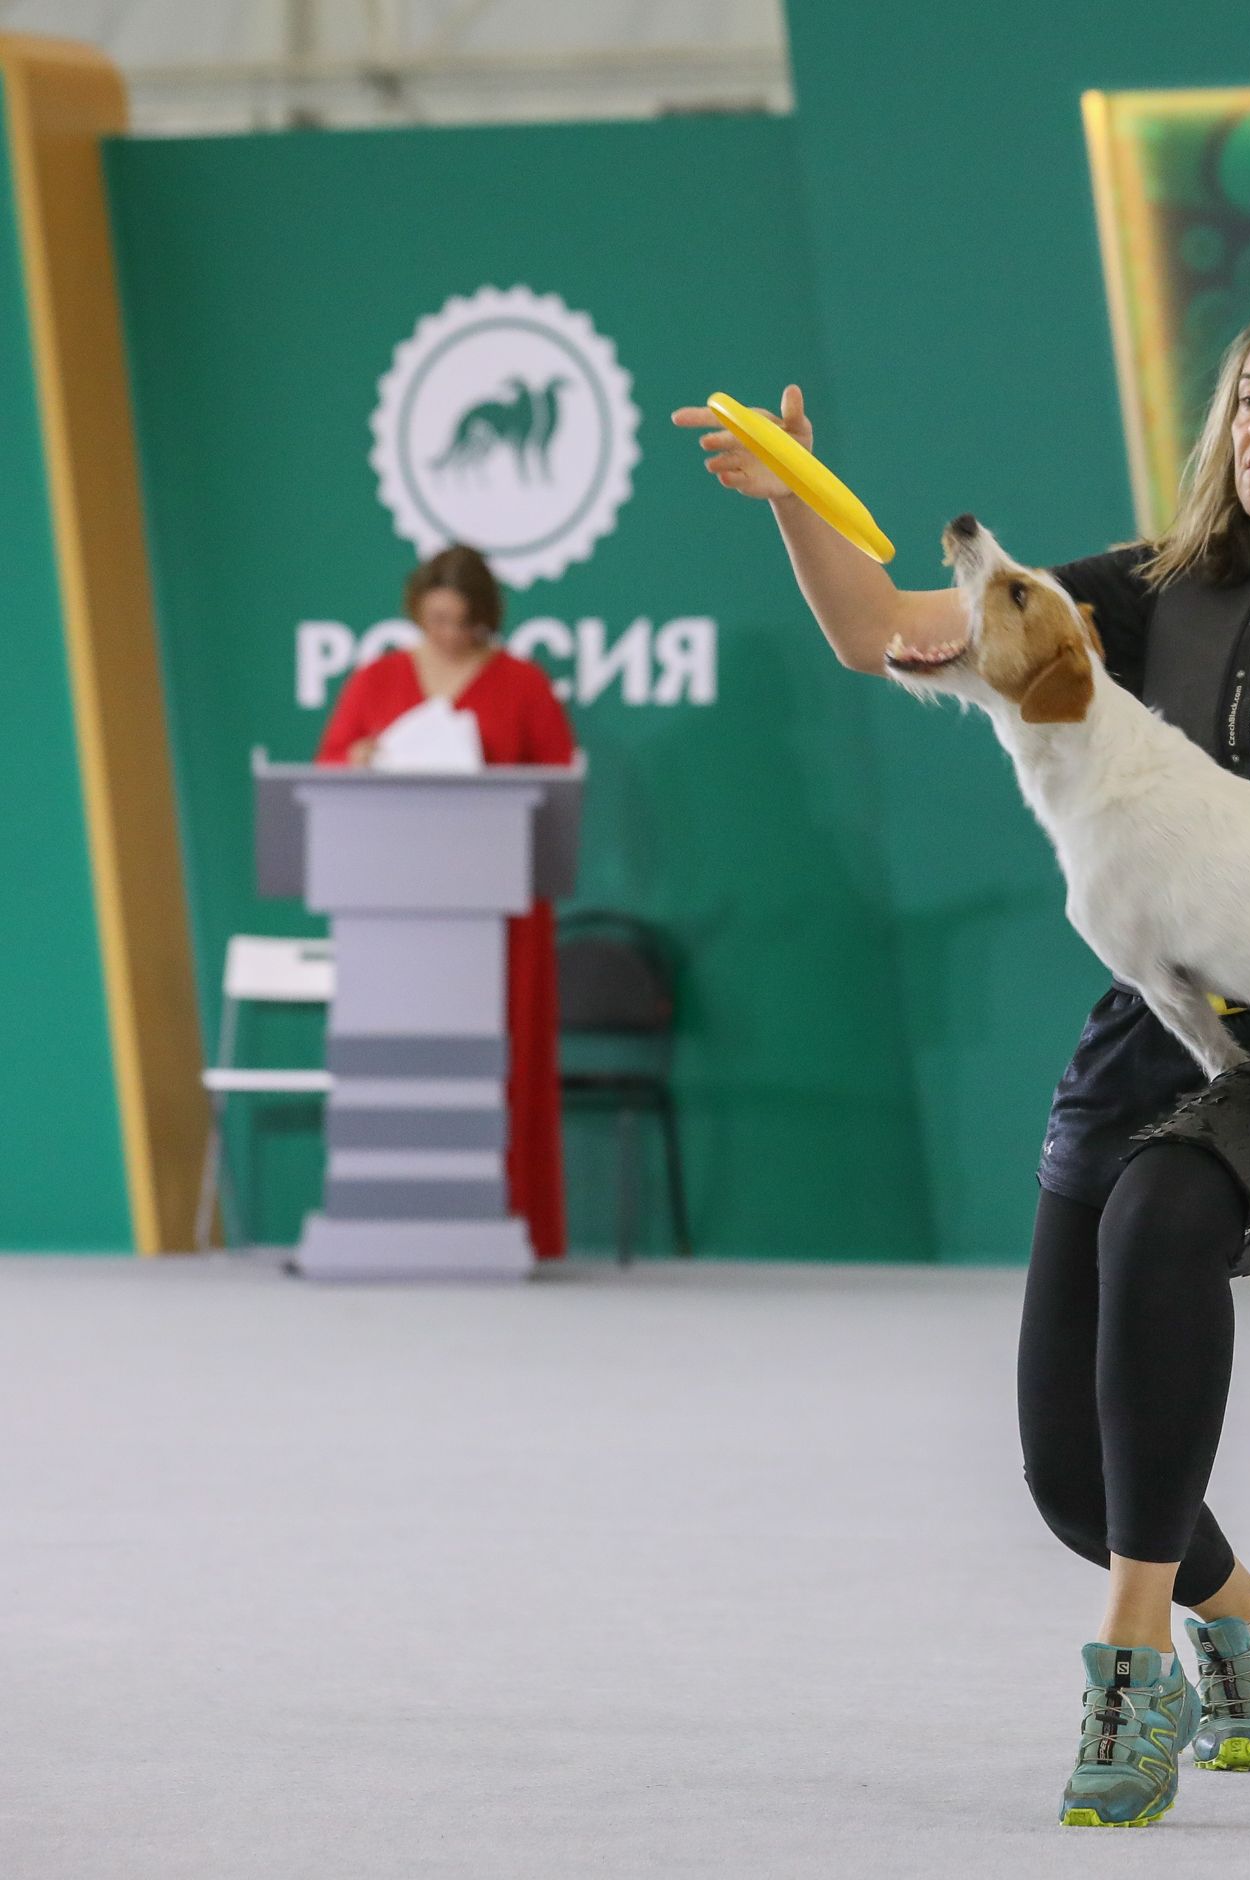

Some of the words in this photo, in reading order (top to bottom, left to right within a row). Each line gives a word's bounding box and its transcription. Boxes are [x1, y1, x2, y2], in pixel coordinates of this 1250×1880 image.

[296, 616, 718, 708] РСИЯ
[1228, 685, 1242, 746] CzechBlack.com
[1117, 1661, 1130, 1675] S
